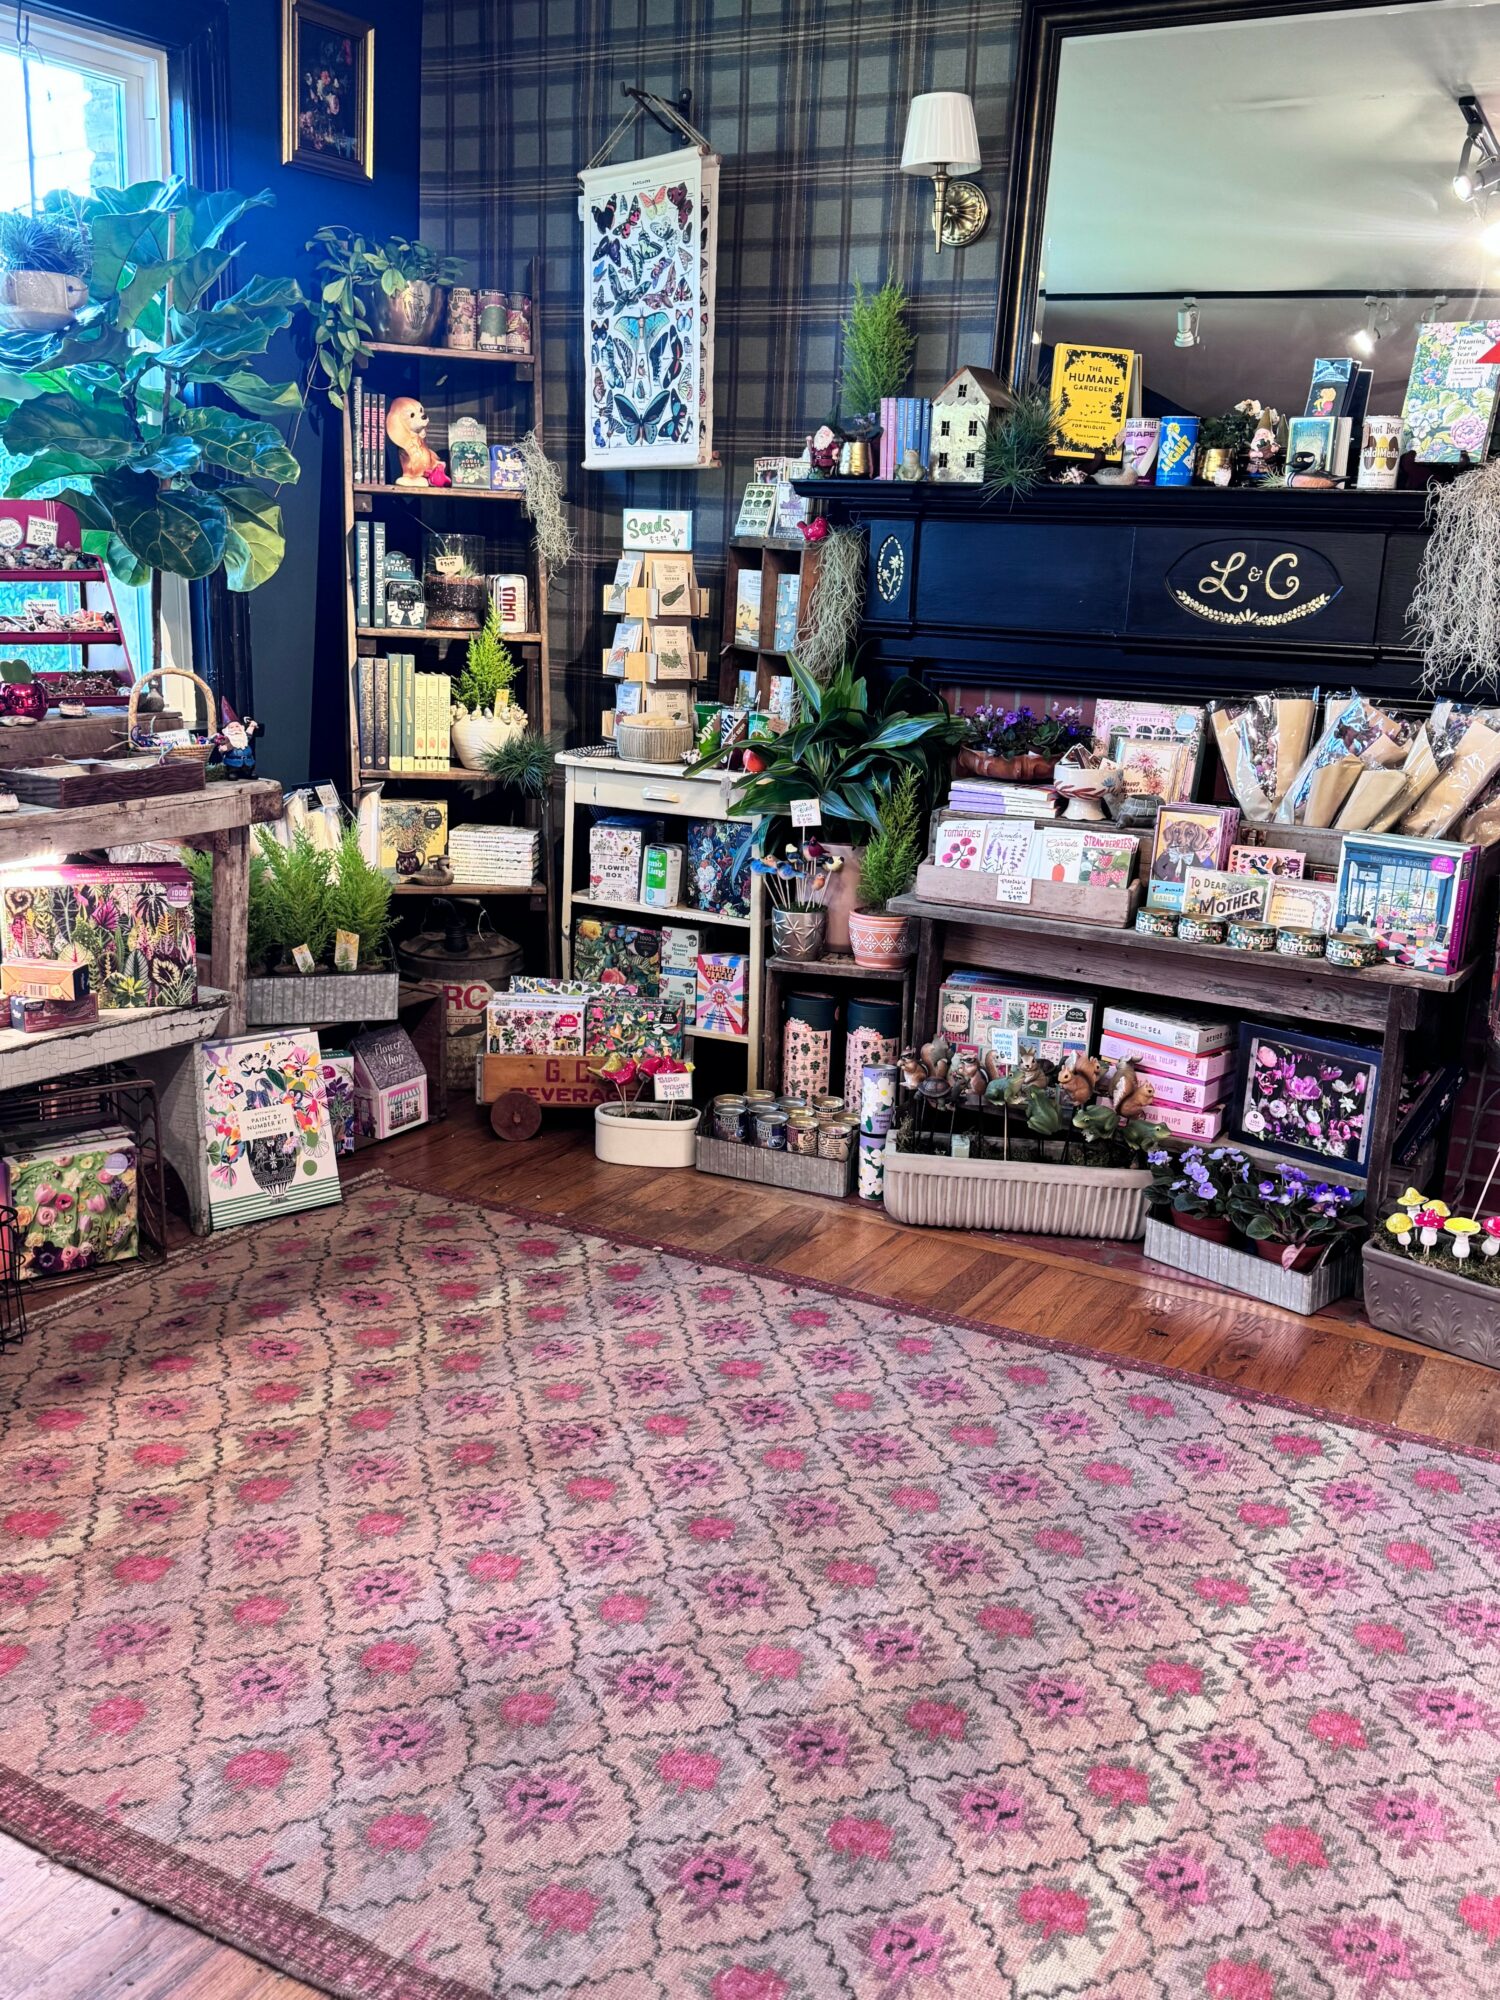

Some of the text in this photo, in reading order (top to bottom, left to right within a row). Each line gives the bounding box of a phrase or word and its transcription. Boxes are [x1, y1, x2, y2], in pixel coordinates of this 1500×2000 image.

[1068, 372, 1120, 385] HUMANE
[1073, 384, 1113, 393] GARDENER
[1144, 421, 1157, 429] FREE
[1369, 423, 1383, 434] oot
[626, 514, 671, 539] Seeds
[359, 538, 368, 605] Hello Tiny World
[375, 539, 384, 606] Hello Tiny World
[1198, 551, 1300, 603] L & C
[944, 829, 981, 838] TOMATOES
[1046, 838, 1079, 848] Carrots
[1084, 834, 1133, 849] STRAWBERRIES
[598, 864, 630, 872] FLOWER
[1204, 878, 1228, 890] DEAR
[1200, 890, 1261, 915] MOTHER
[704, 964, 737, 976] ANXIETY
[706, 971, 734, 982] ORACLE
[945, 1012, 967, 1024] GIANTS
[1115, 1017, 1139, 1029] BESIDE
[1148, 1026, 1161, 1035] SEA
[372, 1040, 401, 1057] Flower
[383, 1053, 404, 1067] Shop
[1159, 1057, 1177, 1067] TULIPS
[545, 1059, 566, 1083] G.
[251, 1115, 271, 1123] PAINT
[1161, 1115, 1181, 1126] TULIPS
[246, 1121, 275, 1131] NUMBER
